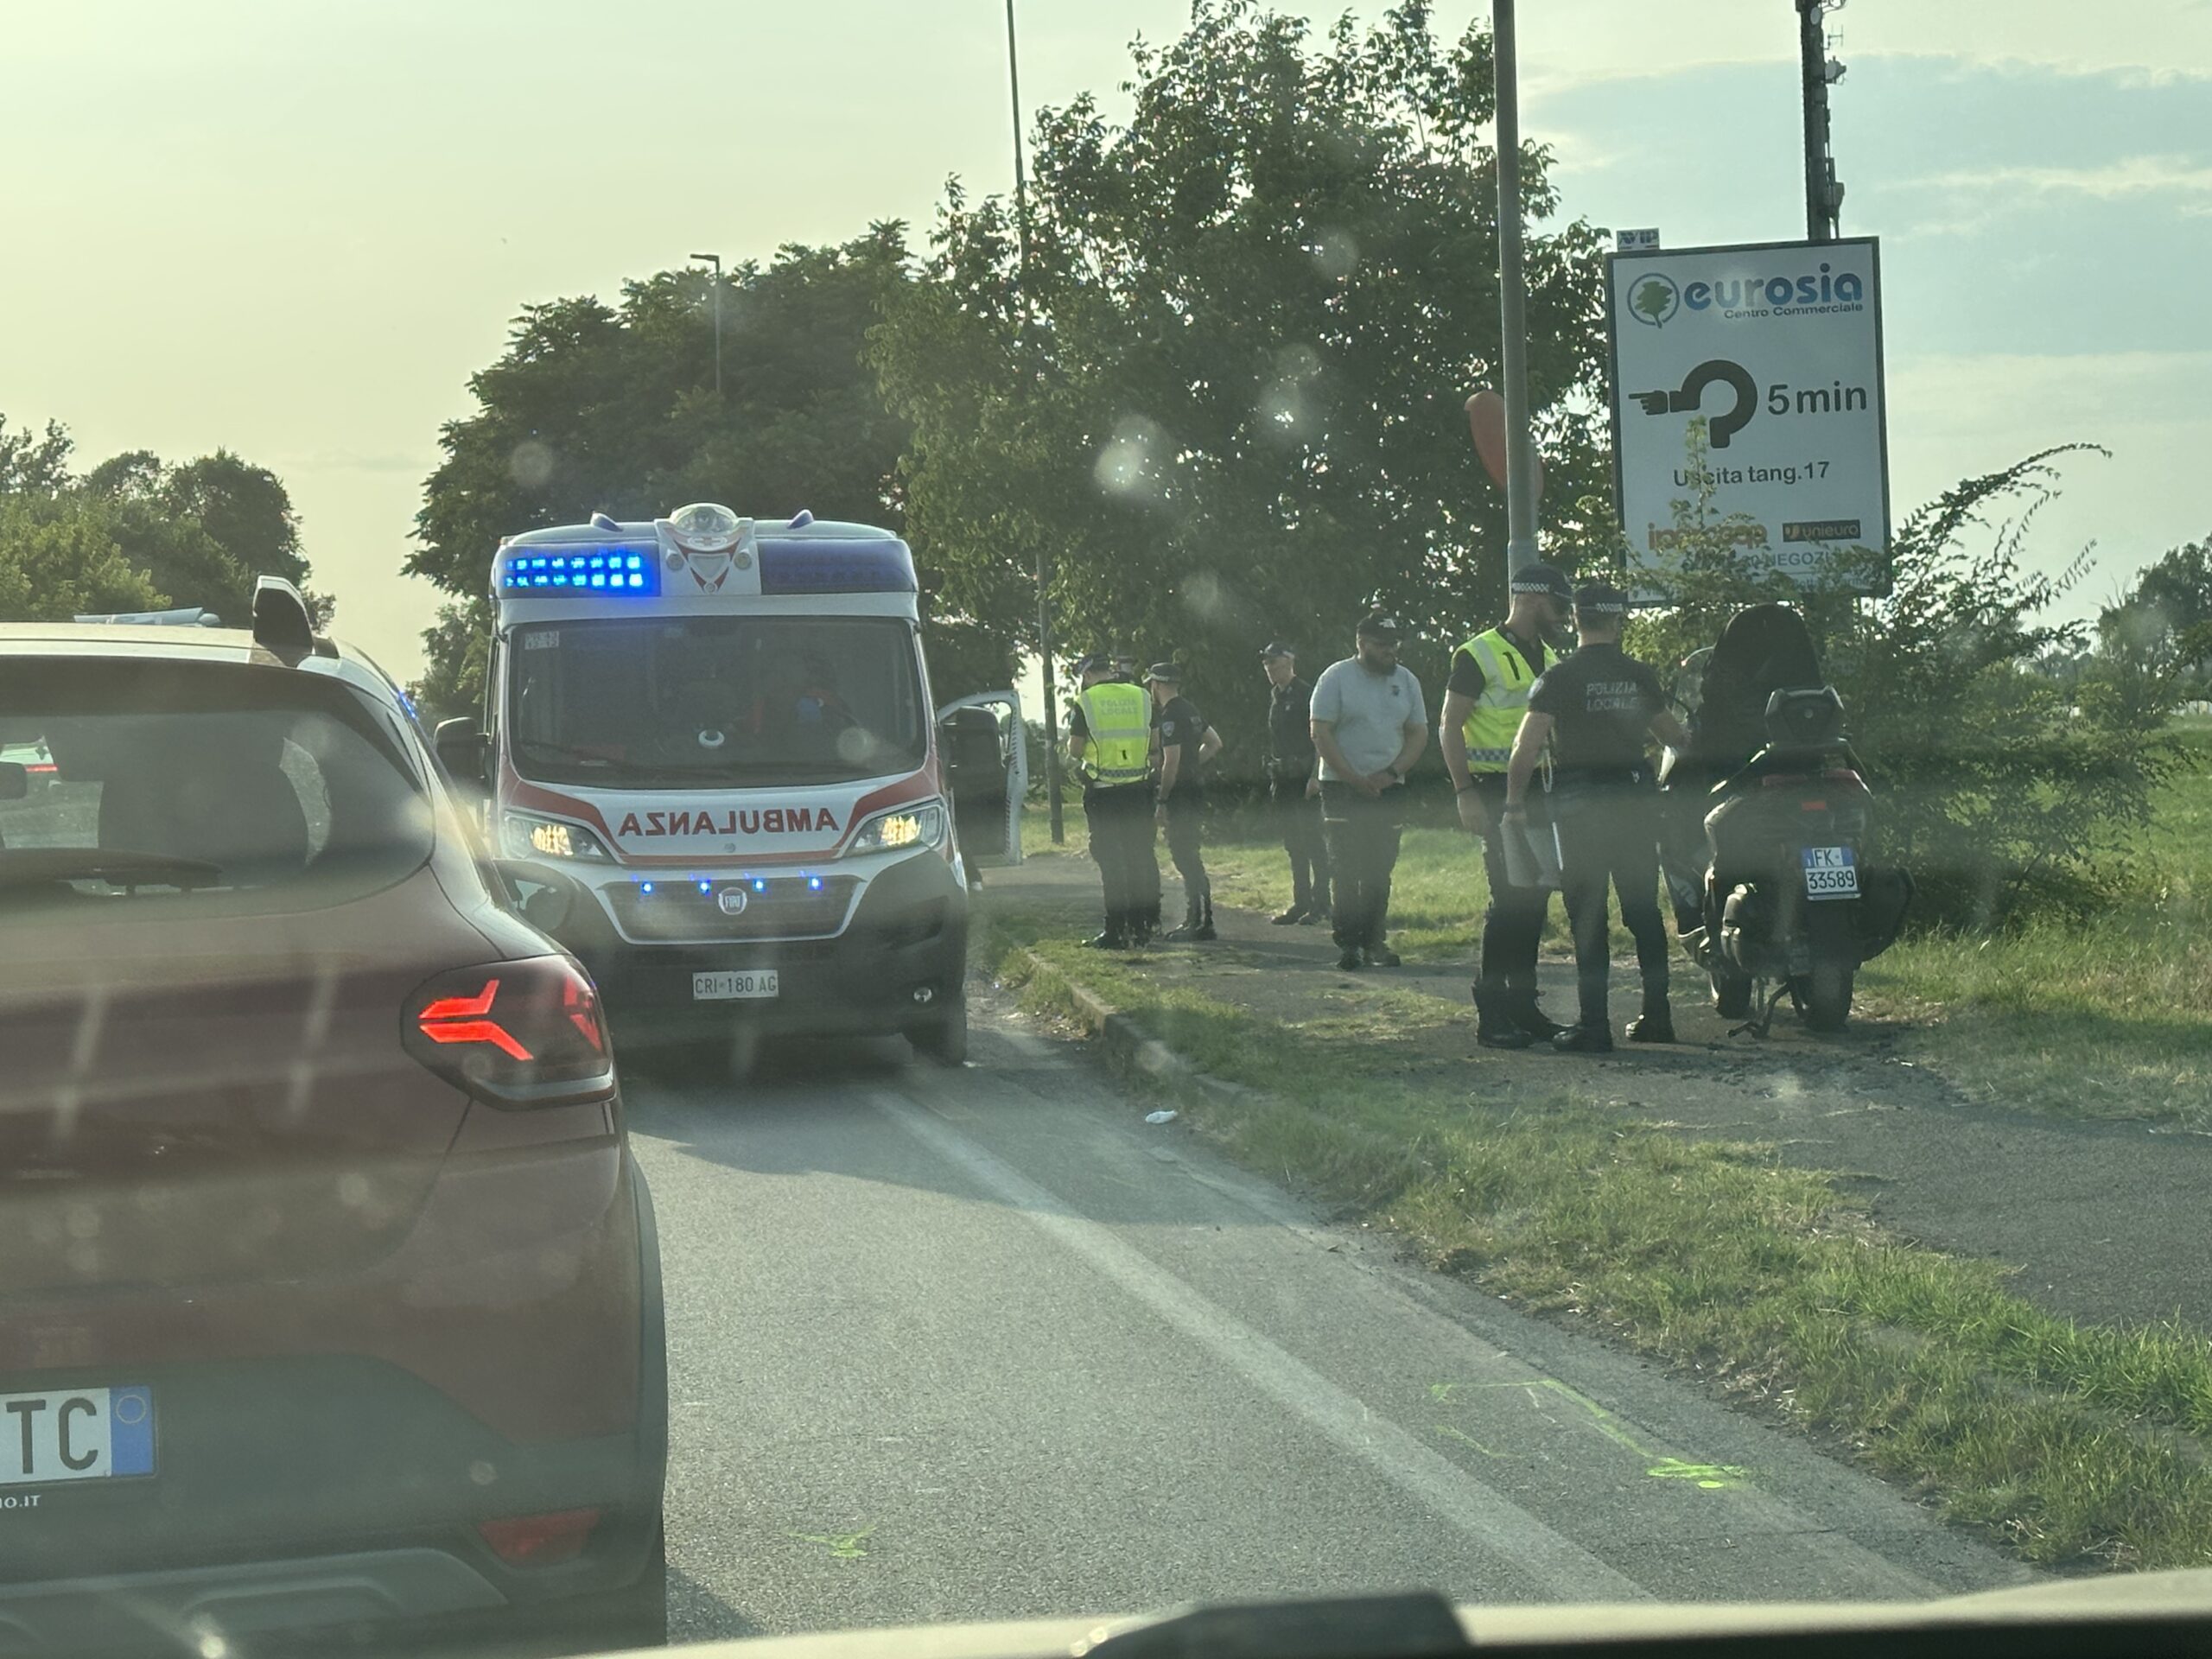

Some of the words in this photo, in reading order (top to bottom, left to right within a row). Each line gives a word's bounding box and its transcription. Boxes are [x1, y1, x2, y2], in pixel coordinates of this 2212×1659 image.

[1684, 263, 1863, 311] eurosia
[1724, 308, 1769, 320] Centro
[1773, 302, 1864, 317] Commerciale
[1802, 524, 1859, 538] unieuro
[1586, 680, 1638, 696] POLIZIA
[1586, 696, 1639, 712] LOCALE
[1815, 849, 1834, 866] FK
[1808, 870, 1855, 889] 33589
[760, 976, 776, 992] AG
[6, 1397, 99, 1474] TC
